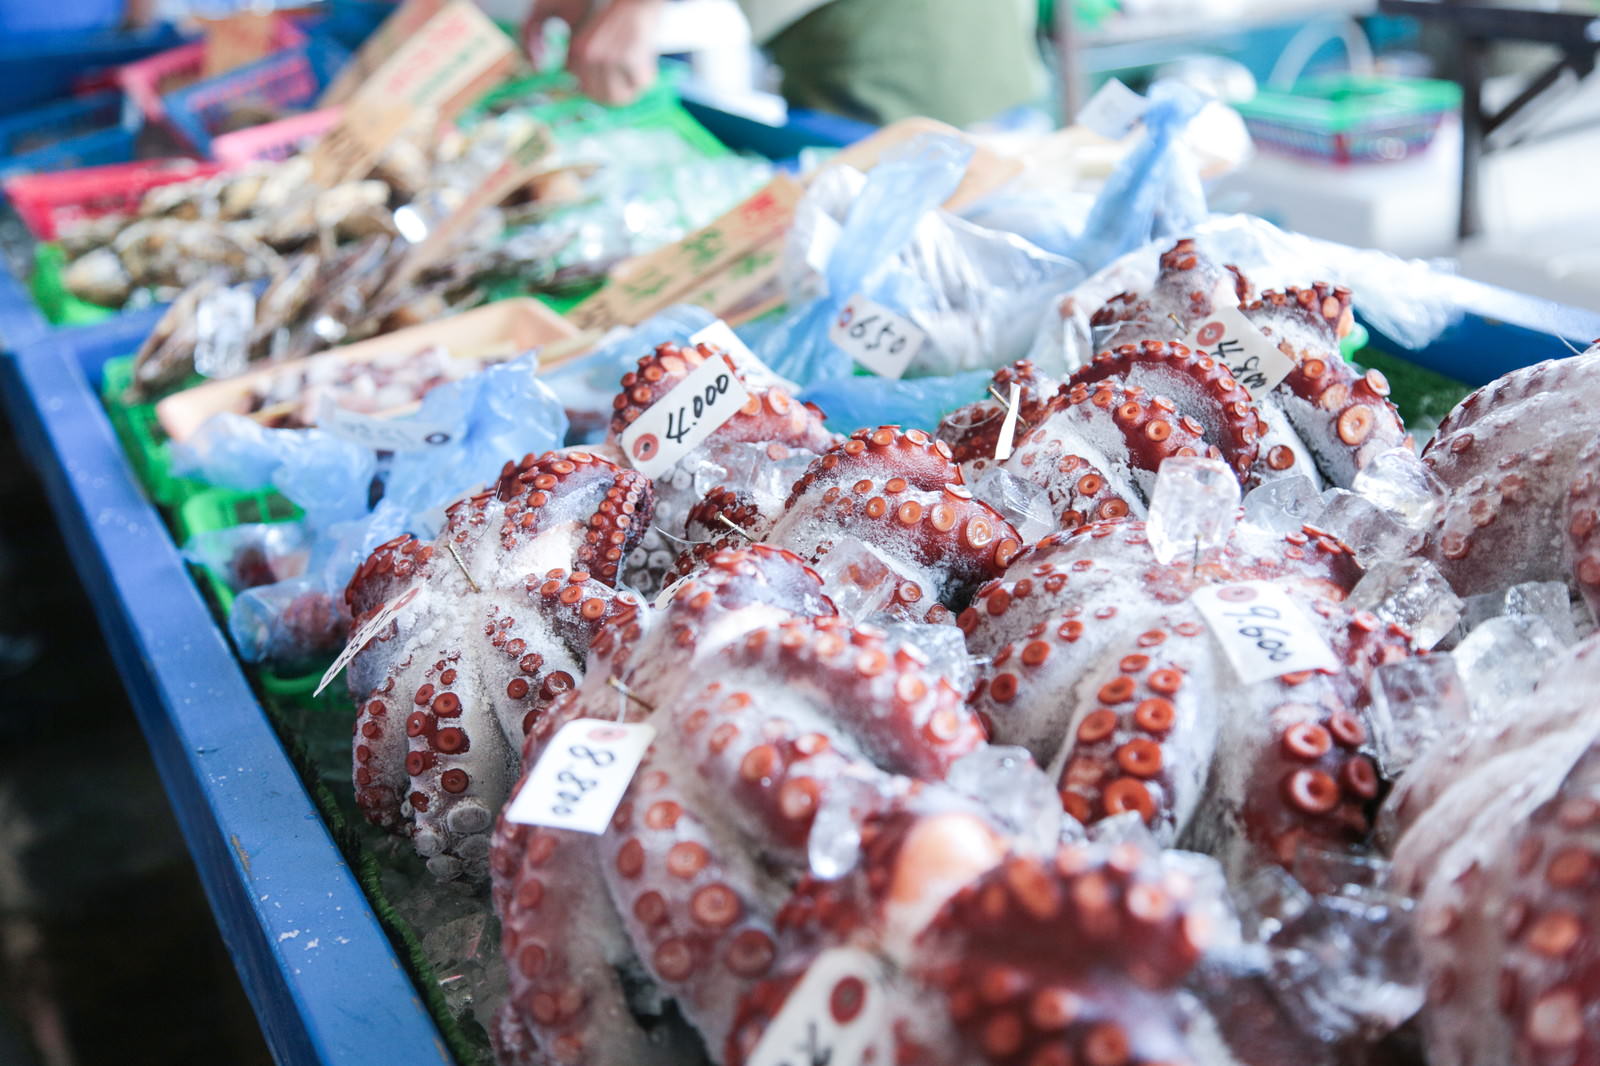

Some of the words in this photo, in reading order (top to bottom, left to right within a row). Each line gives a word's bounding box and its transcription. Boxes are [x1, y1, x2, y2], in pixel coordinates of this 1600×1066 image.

[849, 314, 906, 356] 650
[665, 373, 729, 444] 4.000
[1222, 604, 1293, 663] 9.600
